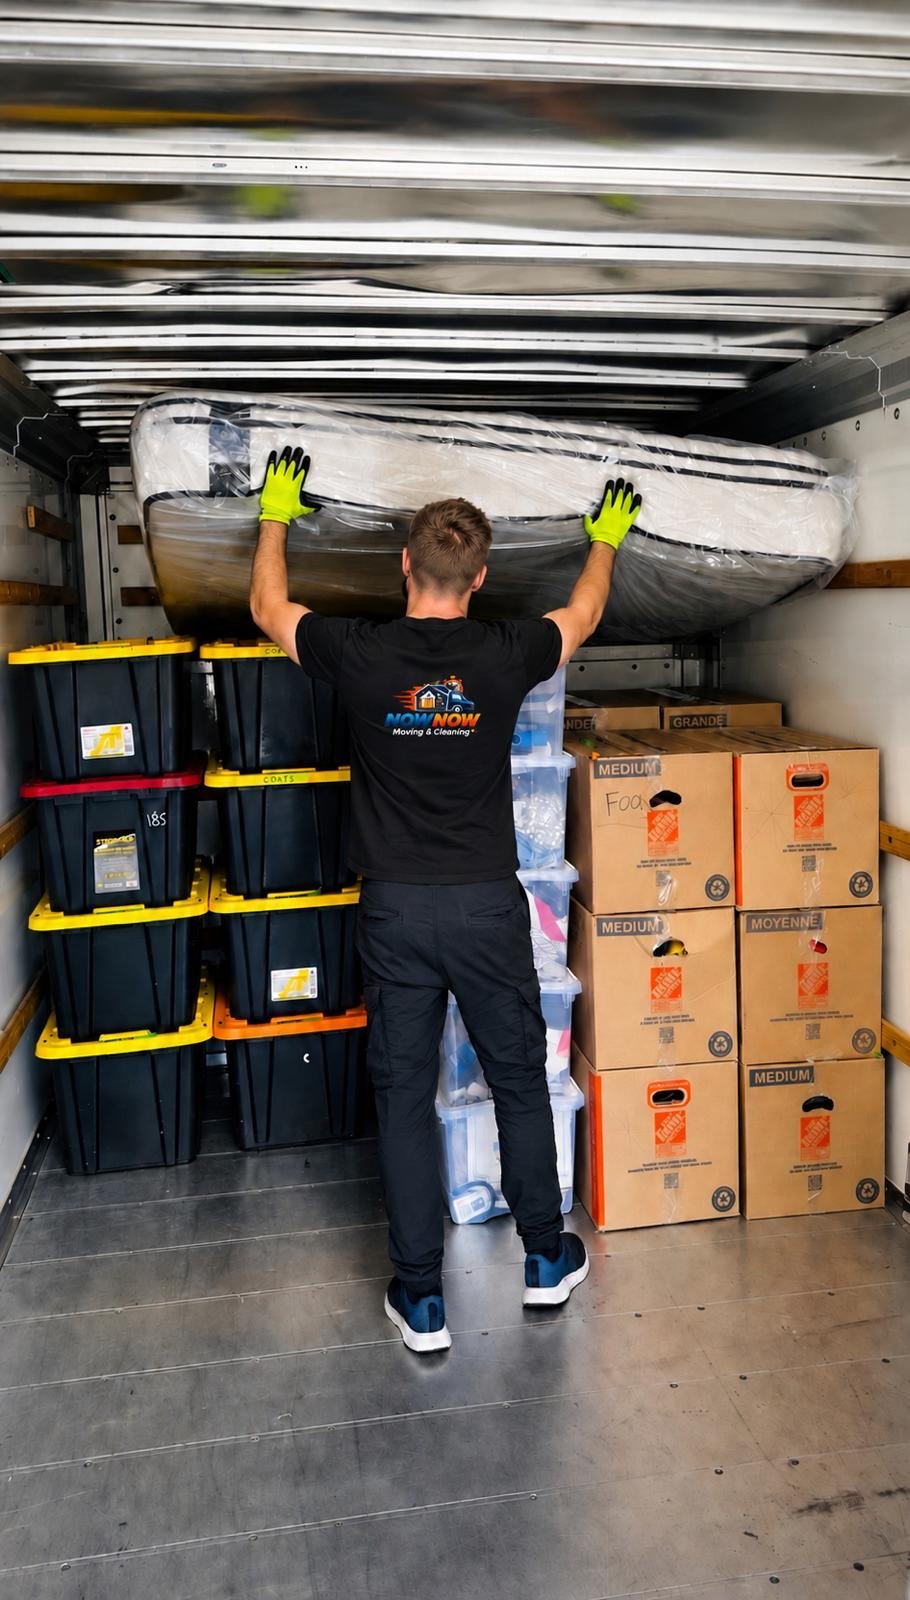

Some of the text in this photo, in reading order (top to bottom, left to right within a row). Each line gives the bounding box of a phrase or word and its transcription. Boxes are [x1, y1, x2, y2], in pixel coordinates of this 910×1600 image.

[673, 716, 723, 728] GRANDE
[392, 728, 424, 737] Moving
[426, 728, 432, 736] &
[599, 762, 656, 776] MEDIUM
[263, 775, 295, 784] COATS
[602, 921, 659, 933] MEDIUM
[751, 916, 819, 930] MOYENNE
[754, 1069, 810, 1083] MEDIUM
